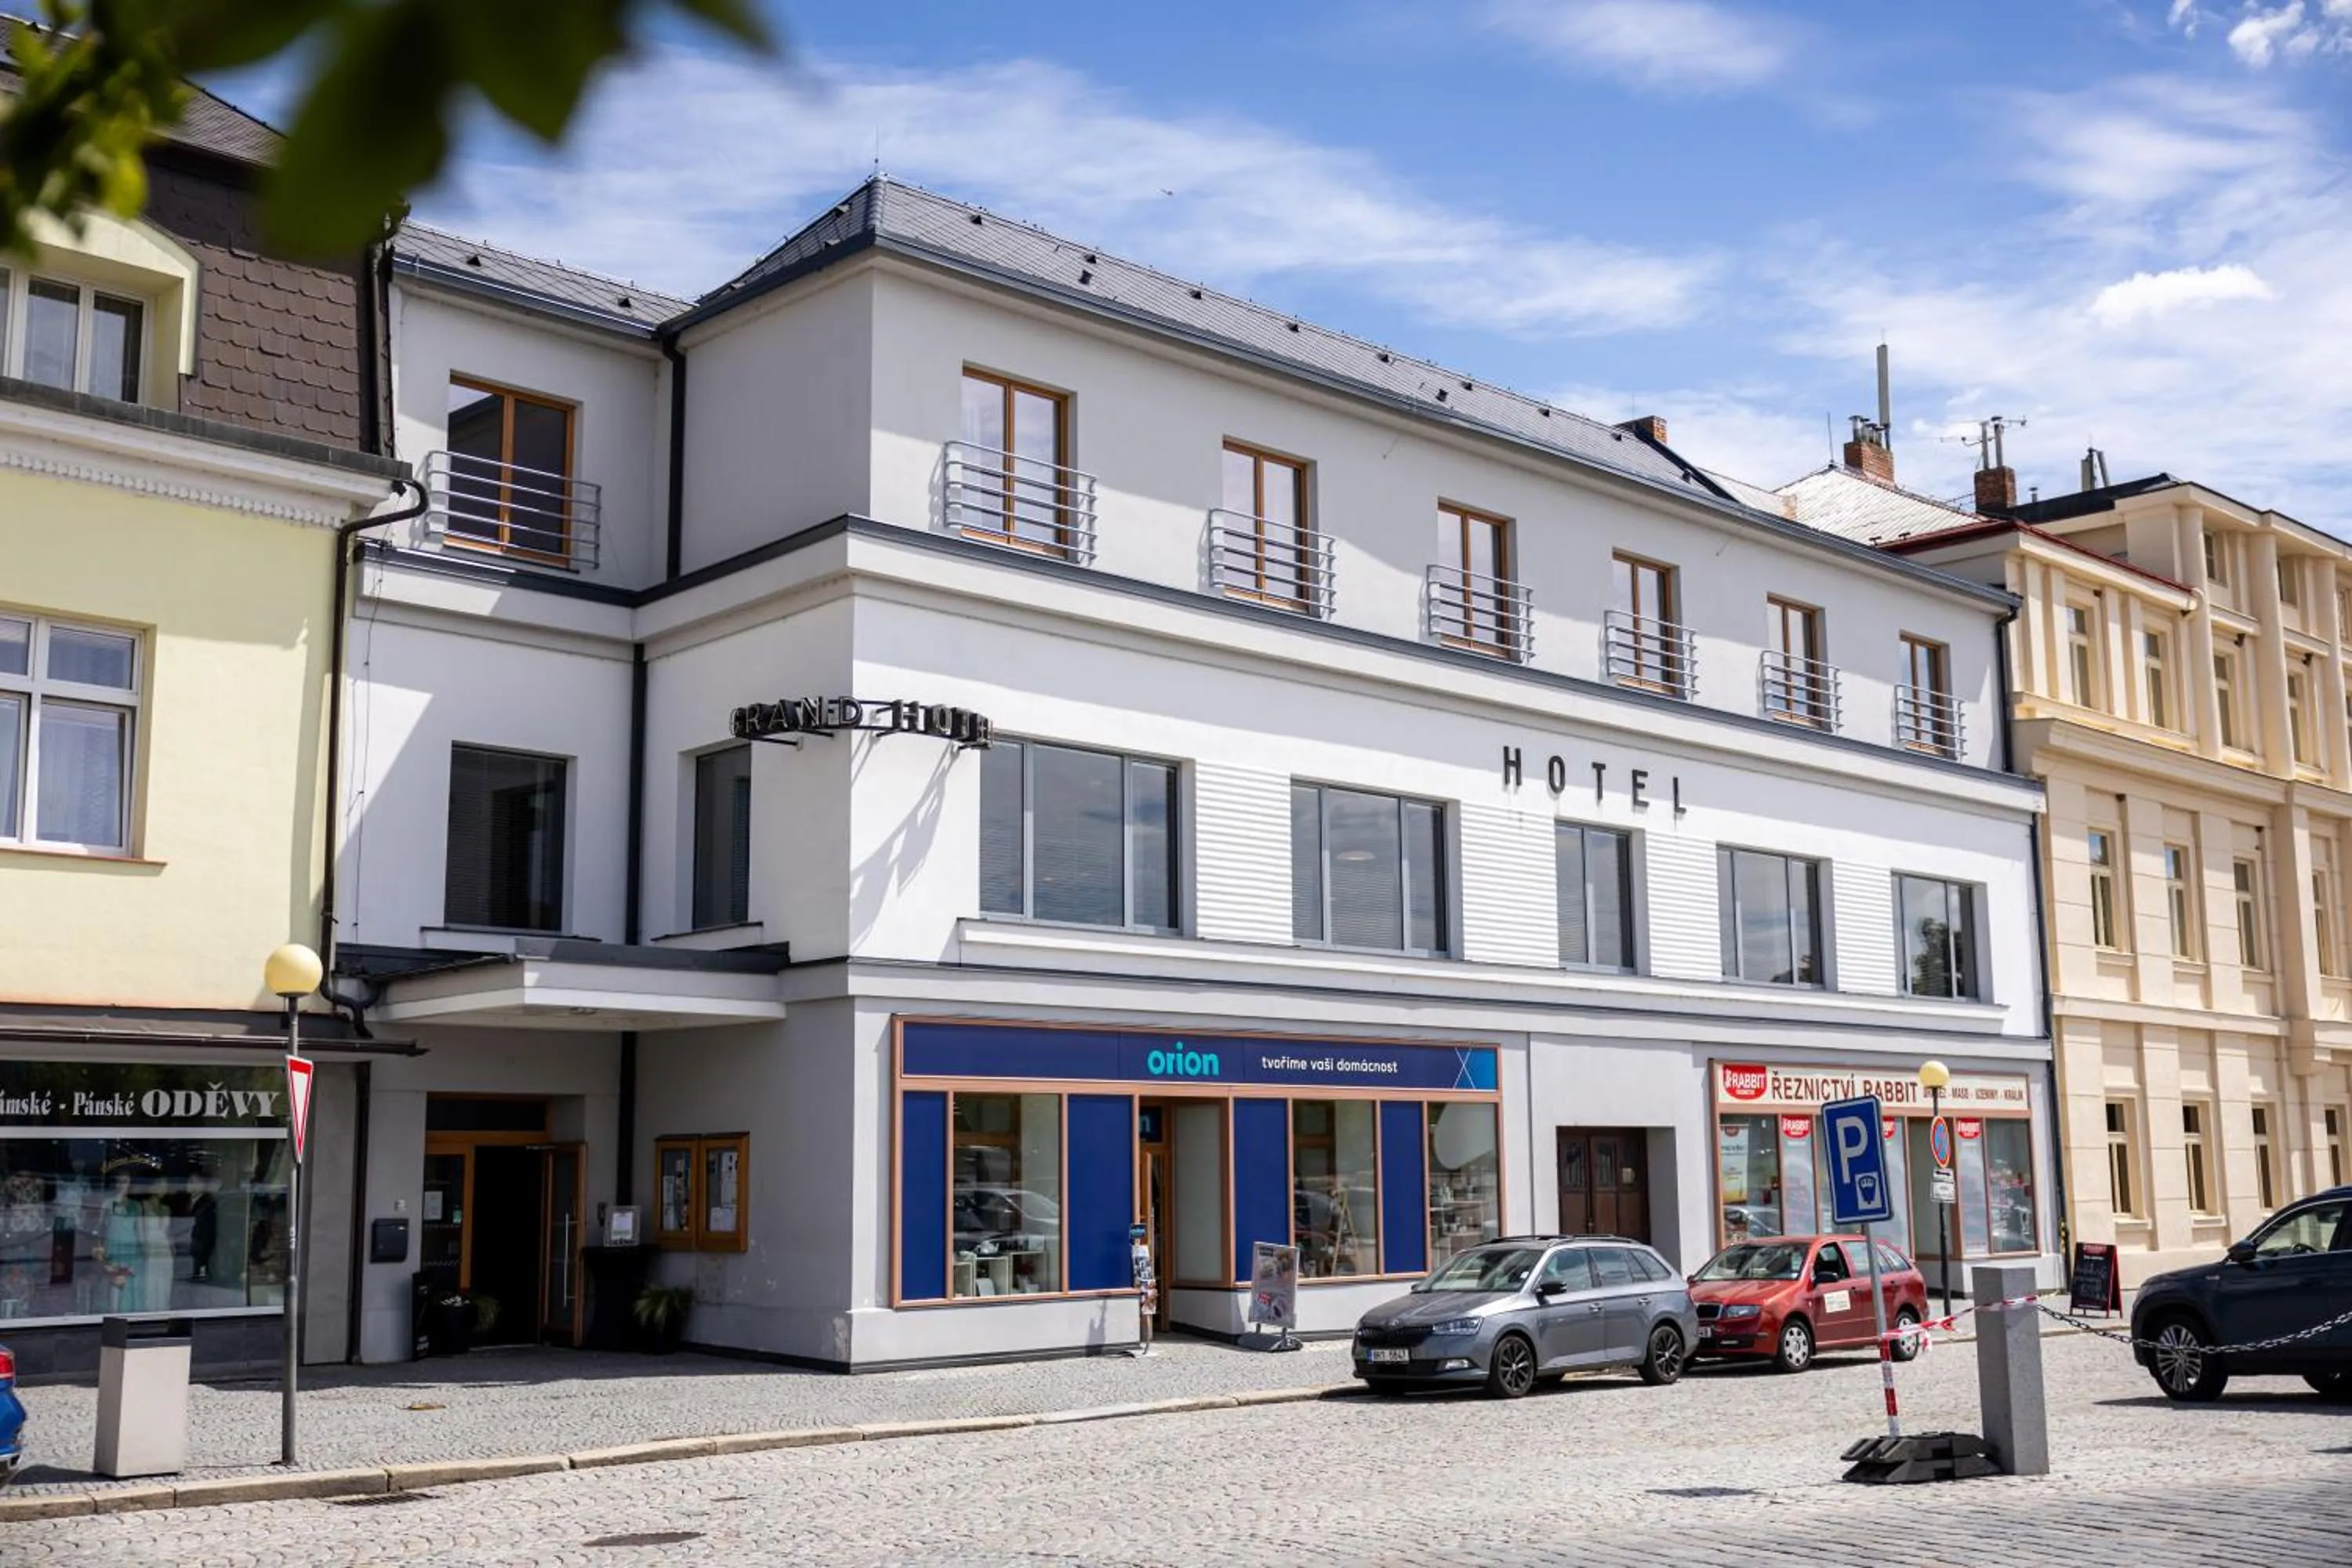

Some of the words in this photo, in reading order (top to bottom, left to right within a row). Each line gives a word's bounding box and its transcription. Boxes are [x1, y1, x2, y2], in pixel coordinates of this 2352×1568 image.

[729, 695, 862, 738] GRAND
[1503, 745, 1687, 814] HOTEL
[1147, 1041, 1220, 1076] orion
[1310, 1058, 1334, 1071] vaši
[1337, 1058, 1398, 1073] domácnost
[1732, 1072, 1766, 1090] RABBIT
[1771, 1071, 1856, 1101] ŘEZNICTVÍ
[1864, 1080, 1918, 1103] RABBIT
[73, 1091, 135, 1116] Pánské
[141, 1081, 280, 1119] ODĚVY
[1836, 1116, 1868, 1184] P
